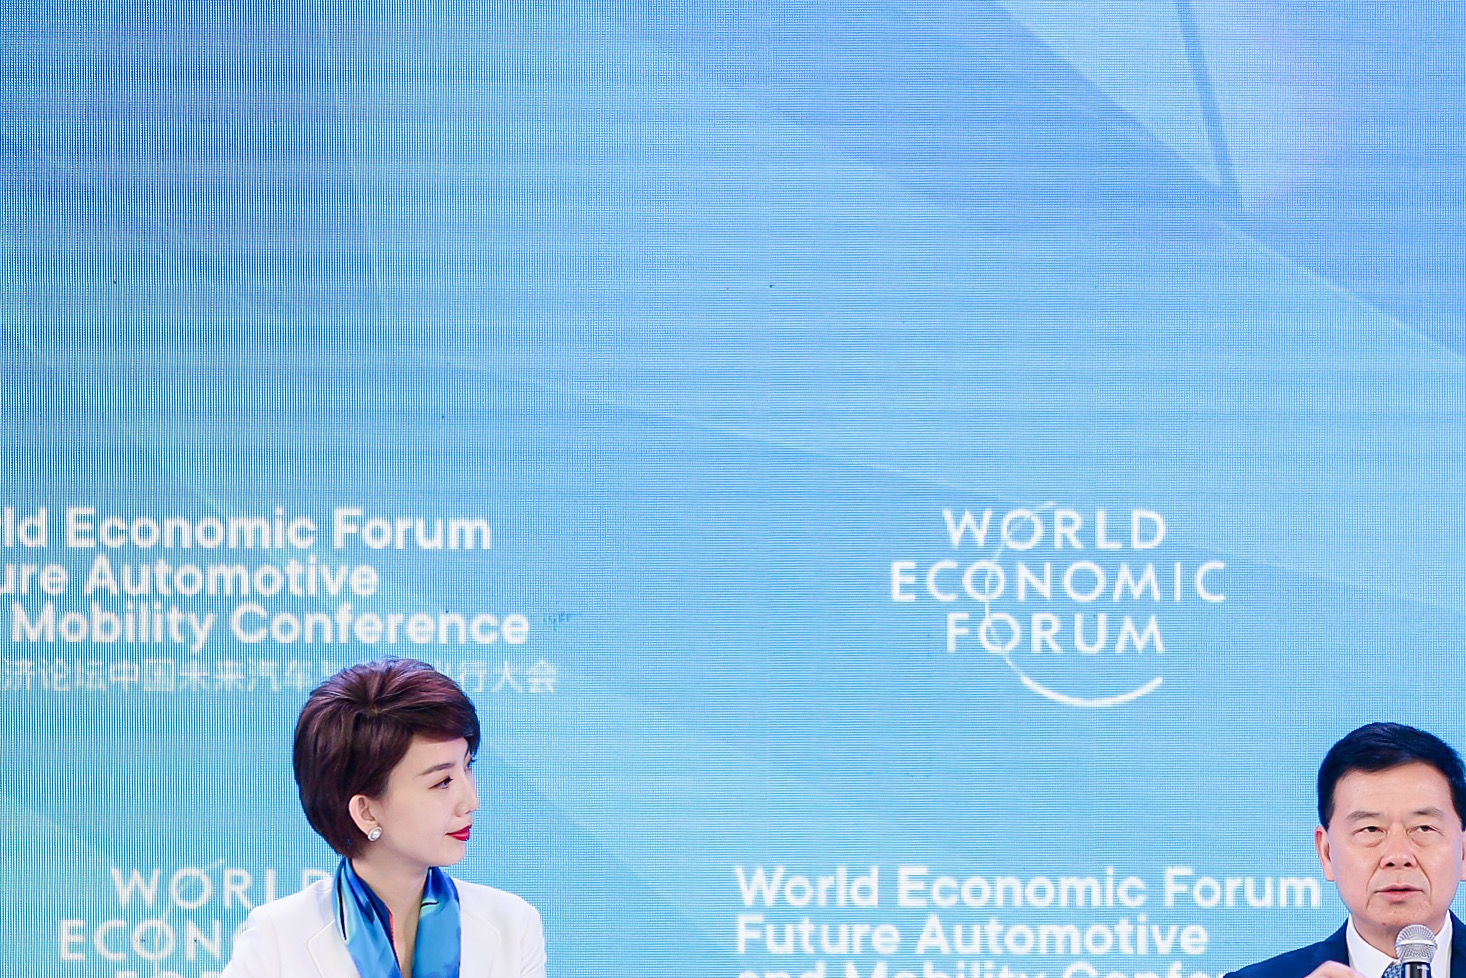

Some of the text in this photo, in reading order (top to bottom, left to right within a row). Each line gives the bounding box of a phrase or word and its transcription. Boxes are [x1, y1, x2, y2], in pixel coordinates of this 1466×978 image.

[66, 506, 317, 550] Economic
[333, 507, 491, 550] Forum
[942, 508, 1167, 551] WORLD
[0, 553, 379, 598] ure Automotive
[891, 559, 1226, 606] ECONOMIC
[11, 601, 530, 654] Mobility Conference
[947, 609, 1165, 654] FORUM
[734, 863, 1325, 908] World Economic Forum
[60, 919, 246, 960] ECON
[736, 914, 1209, 955] Future Automotive
